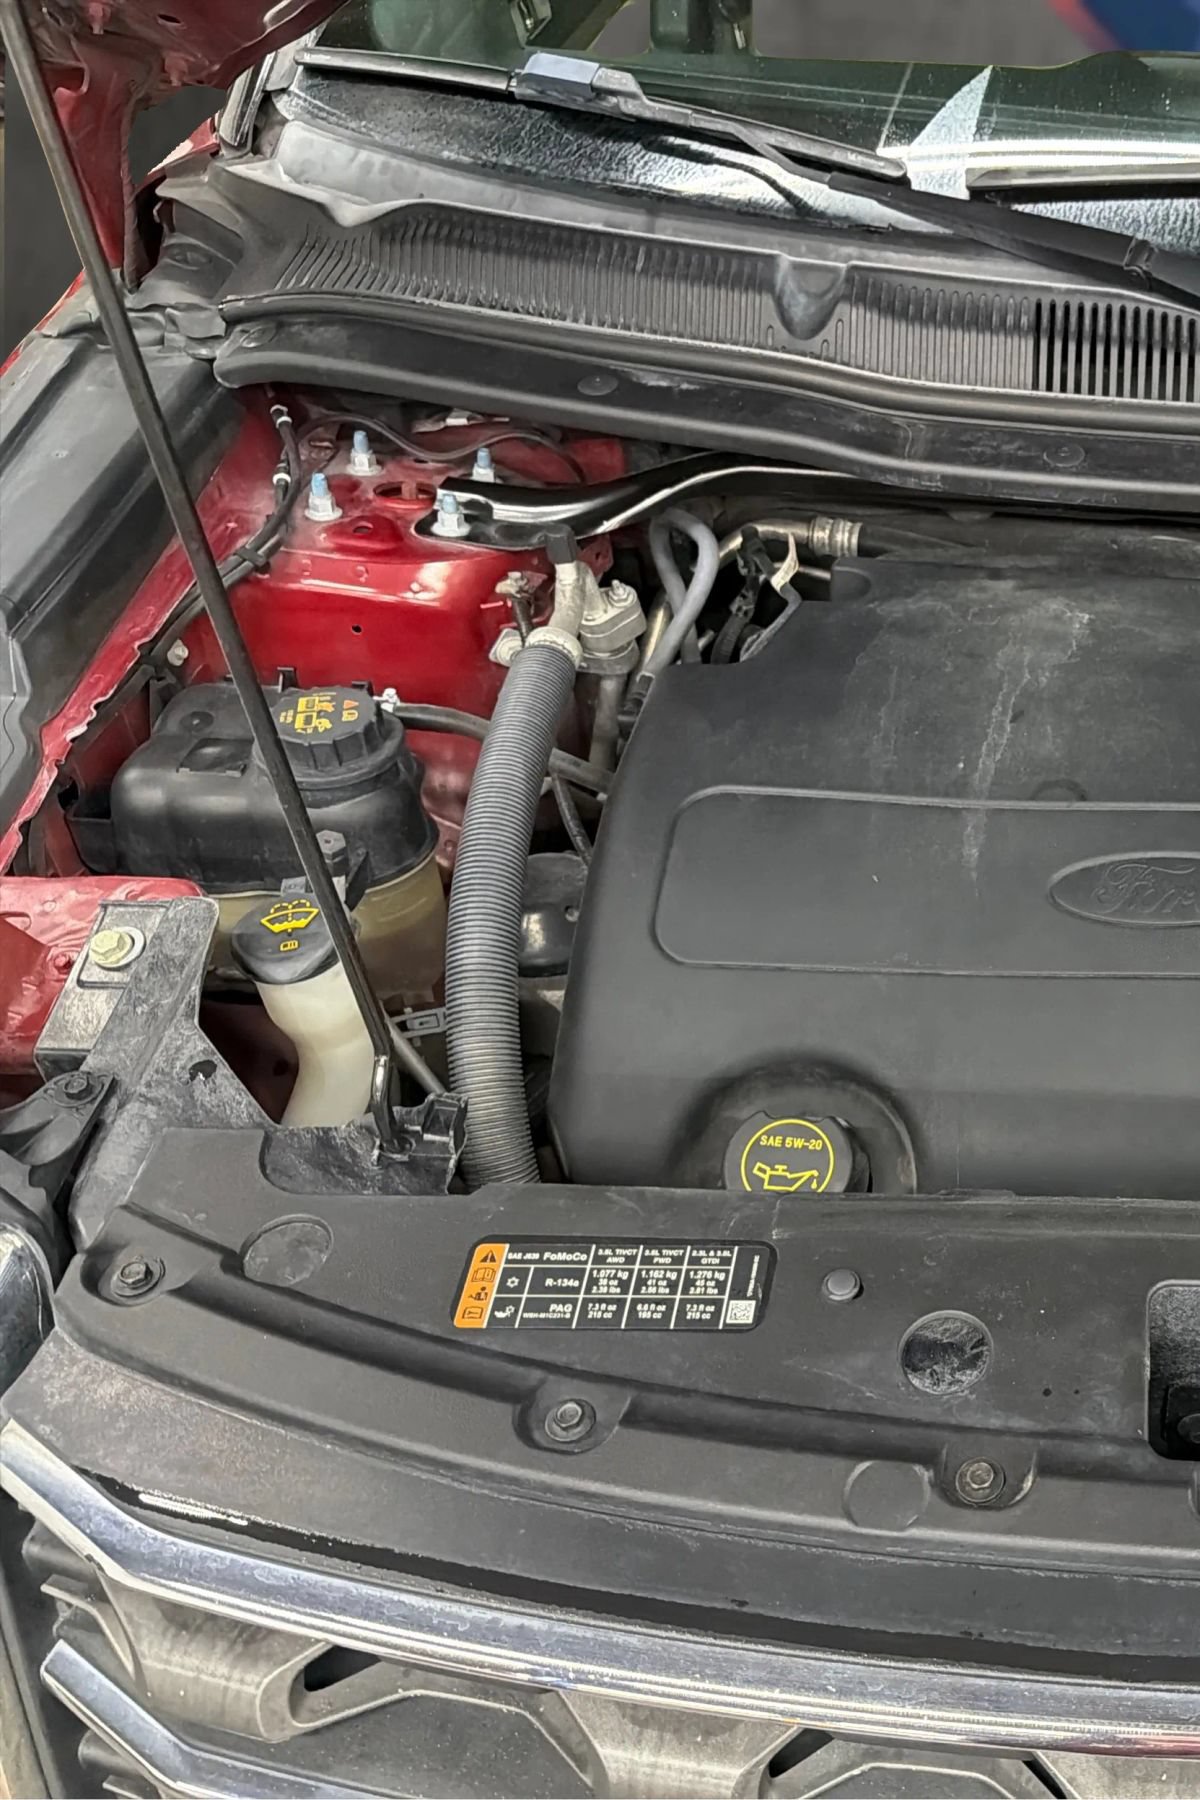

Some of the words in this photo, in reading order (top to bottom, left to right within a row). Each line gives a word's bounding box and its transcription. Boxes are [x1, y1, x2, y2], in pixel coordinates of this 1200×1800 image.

[759, 1134, 783, 1147] SAE
[785, 1136, 823, 1151] 5W-20
[507, 1252, 522, 1260] SAE
[543, 1251, 588, 1262] FoMoCo
[606, 1256, 626, 1264] AWD
[592, 1269, 616, 1278] 1.077
[617, 1270, 629, 1280] kg
[641, 1270, 665, 1279] 1.162
[666, 1270, 678, 1281] kg
[689, 1271, 713, 1279] 1.276
[714, 1271, 726, 1281] kg
[545, 1278, 580, 1287] R-134a
[609, 1286, 621, 1294] lbs
[658, 1286, 670, 1294] lbs
[706, 1287, 719, 1295] lbs
[549, 1304, 573, 1312] PAG
